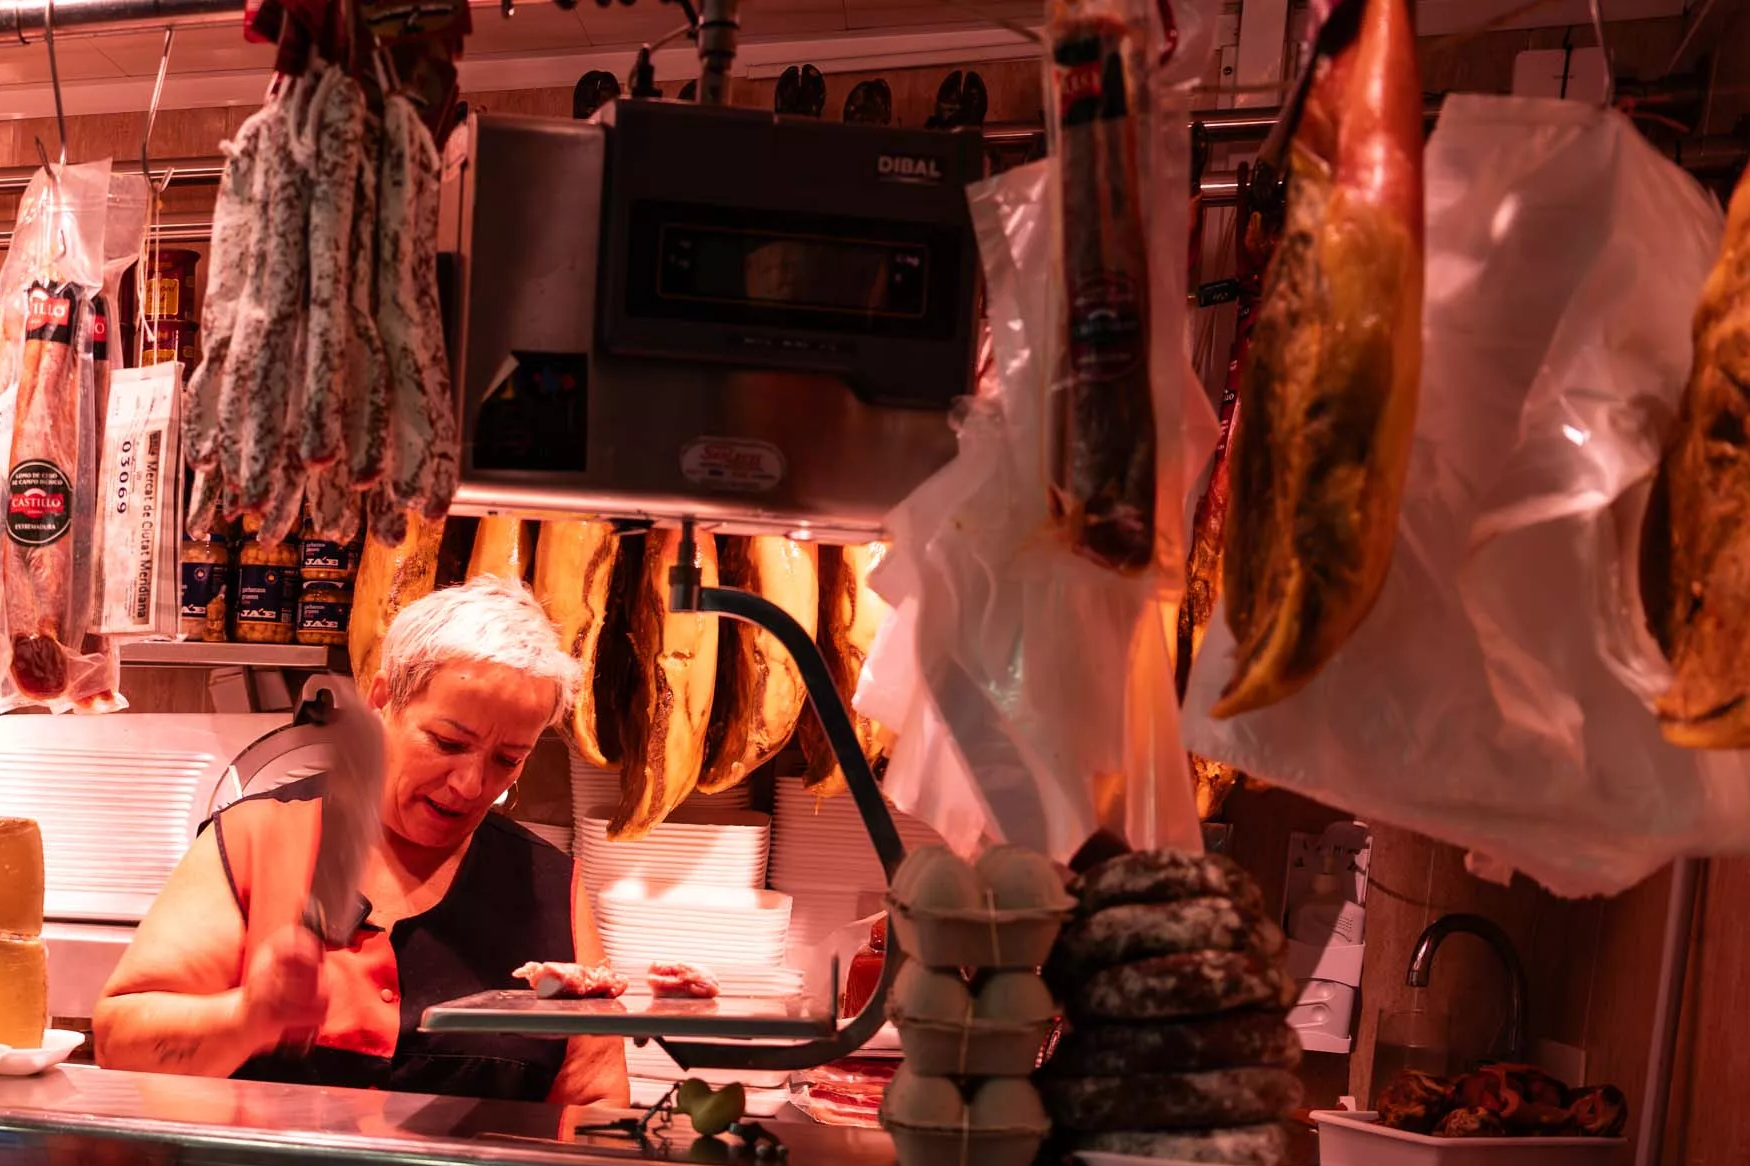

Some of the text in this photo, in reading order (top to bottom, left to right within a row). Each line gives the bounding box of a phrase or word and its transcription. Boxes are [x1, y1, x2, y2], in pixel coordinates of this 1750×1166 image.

[877, 154, 942, 178] DIBAL
[116, 440, 132, 514] 03069
[144, 460, 158, 501] Mercat
[11, 496, 61, 508] CASTILLO
[142, 505, 154, 518] de
[140, 521, 154, 555] Ciutat
[137, 560, 151, 619] Meridiana
